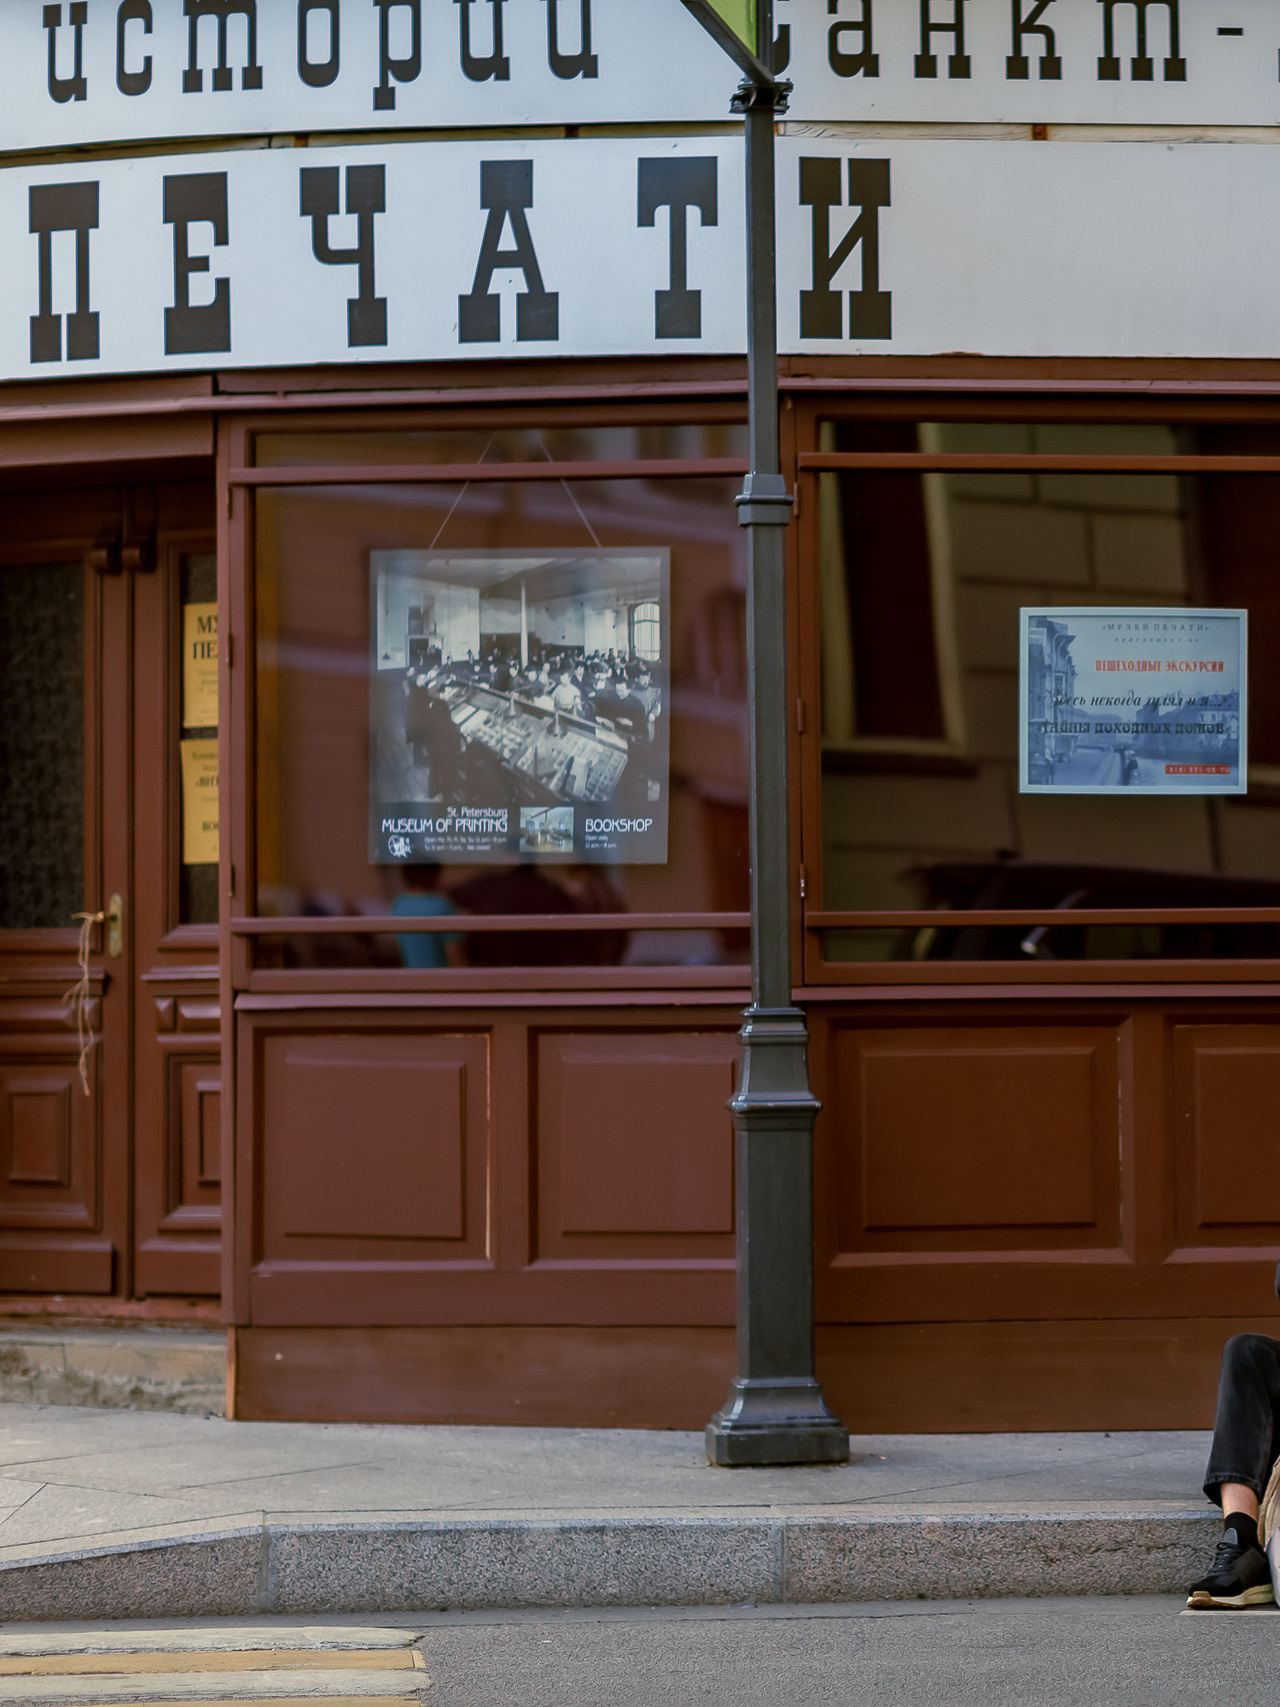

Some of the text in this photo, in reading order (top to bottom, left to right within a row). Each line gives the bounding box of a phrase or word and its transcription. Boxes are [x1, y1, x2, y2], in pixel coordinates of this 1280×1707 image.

[28, 156, 893, 364] ПЕЧАТИ
[1095, 660, 1224, 672] ПЕШЕХОДНЫЕ ЭКСКУРСИИ
[1090, 689, 1141, 706] некогда
[1146, 696, 1182, 712] гулял
[447, 806, 508, 819] St. Petersburg
[381, 818, 508, 833] MUSEUM OF PRINTING
[585, 818, 653, 833] BOOKSHOP
